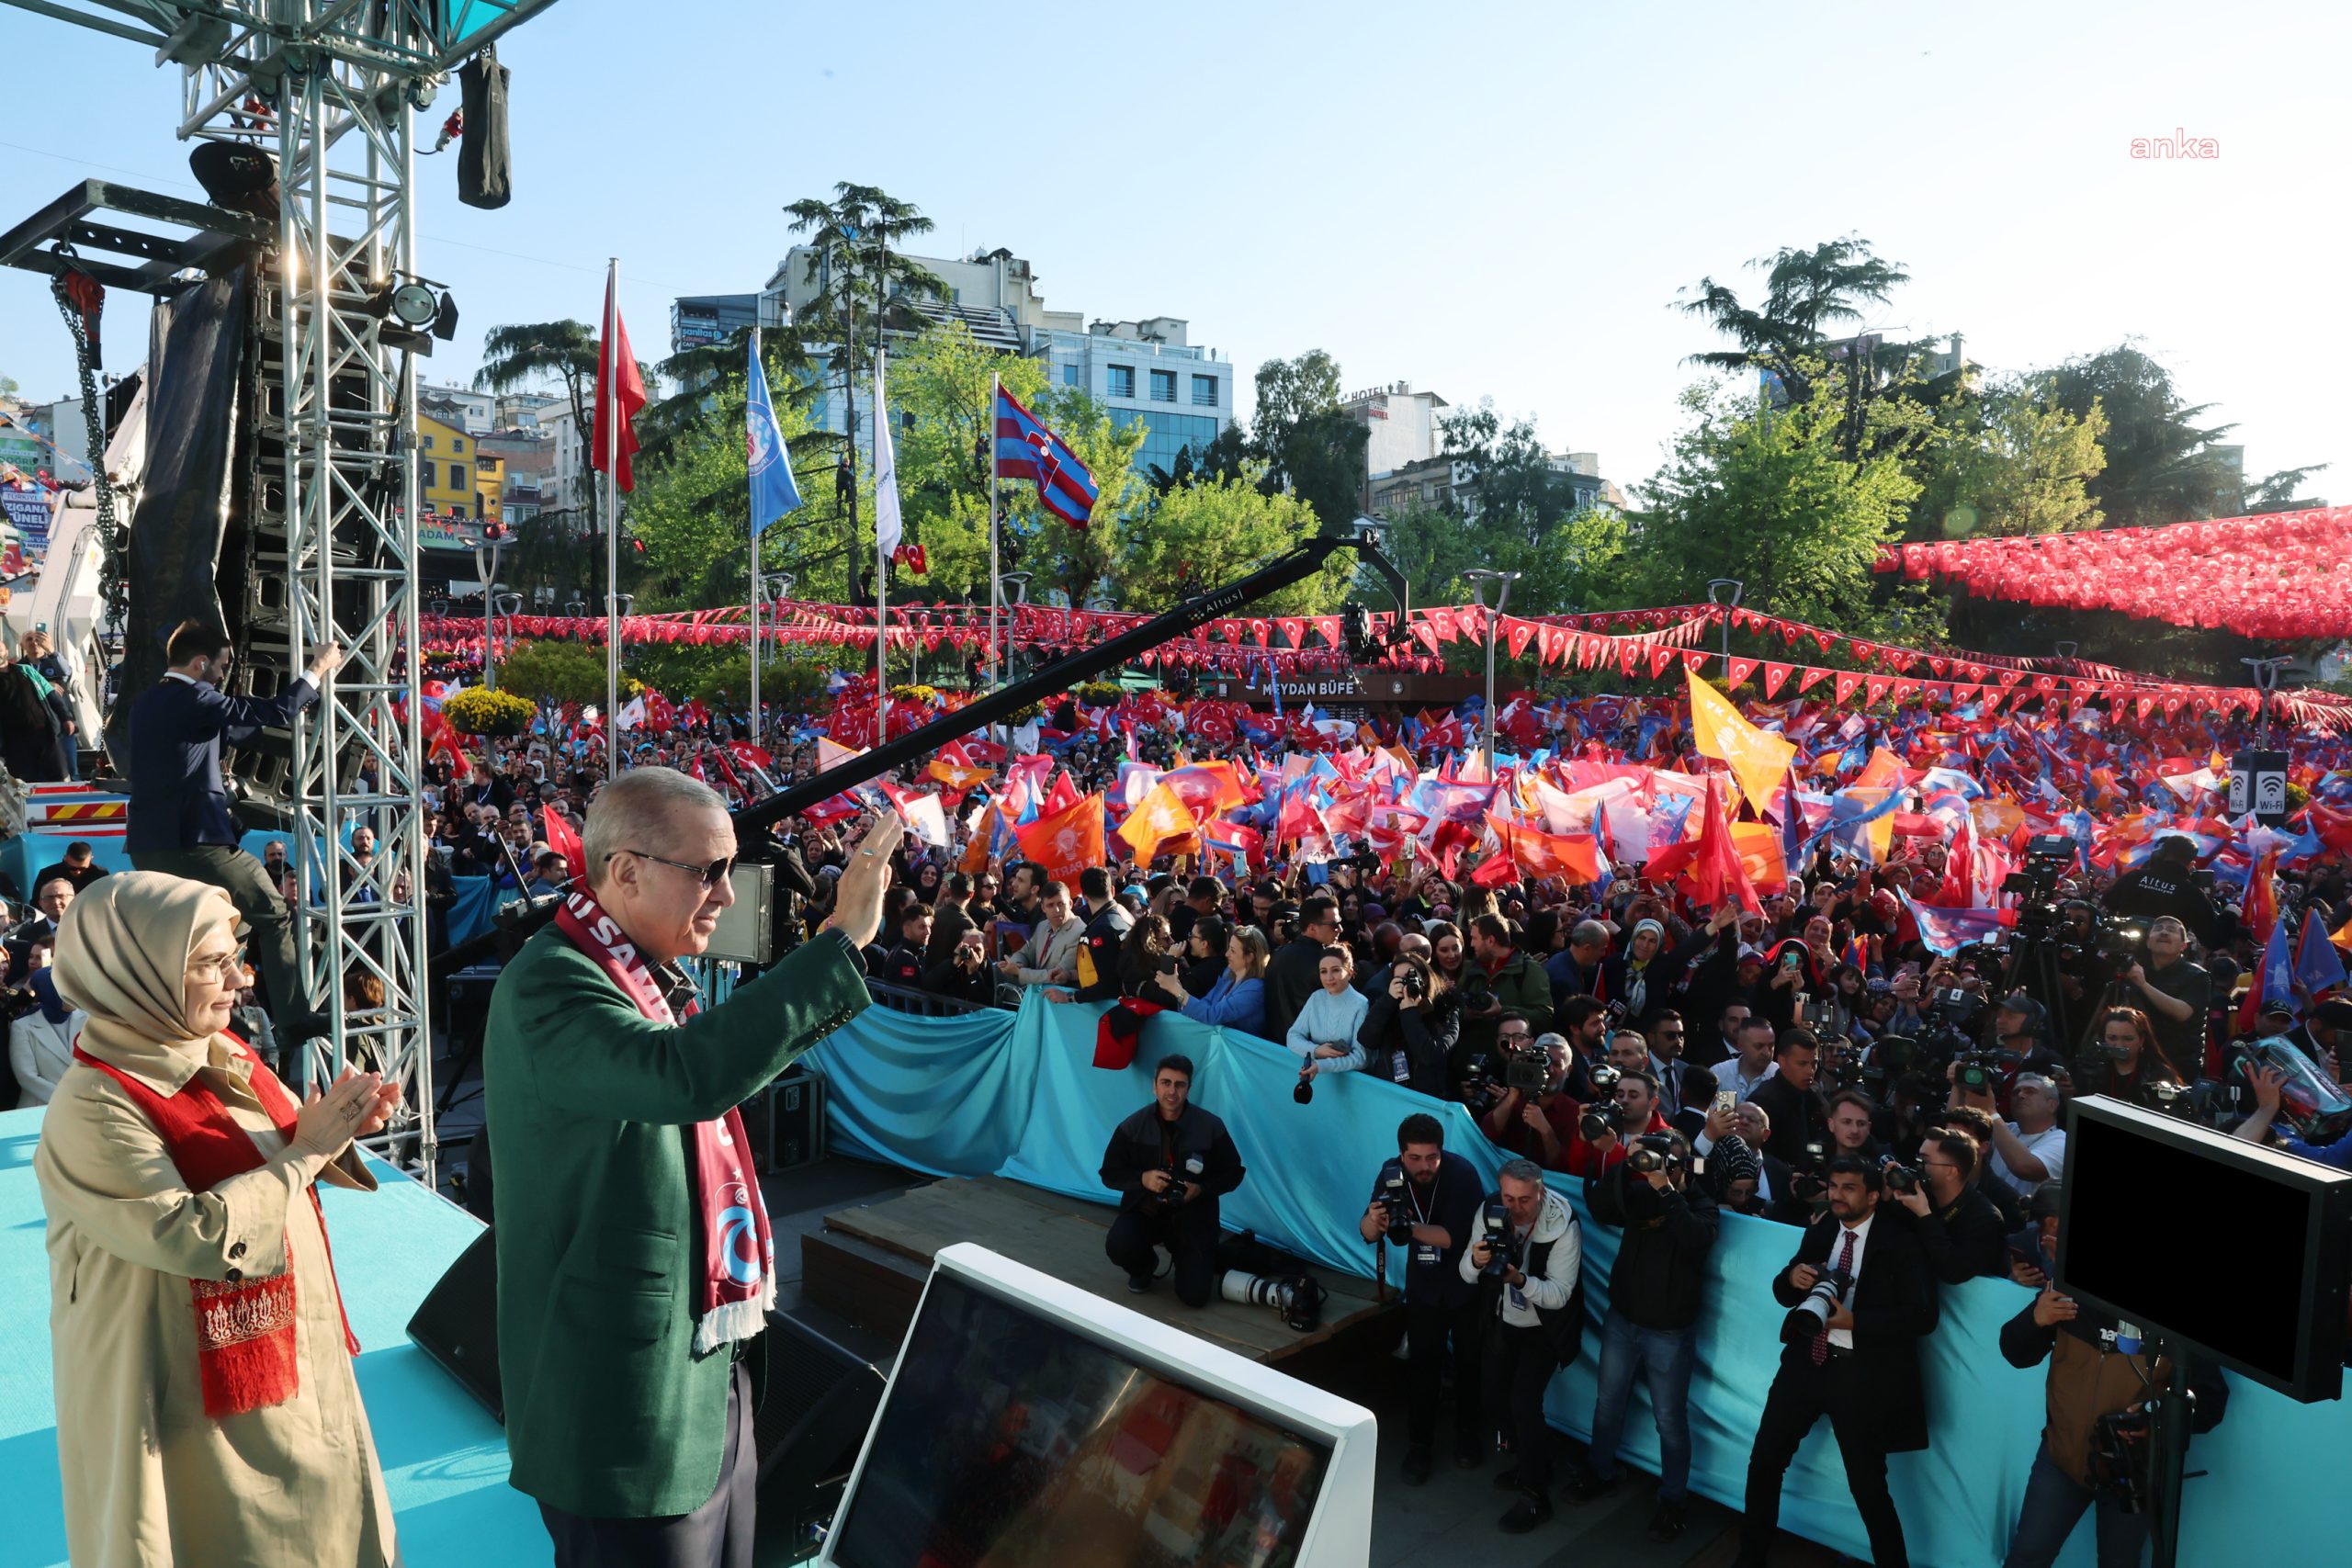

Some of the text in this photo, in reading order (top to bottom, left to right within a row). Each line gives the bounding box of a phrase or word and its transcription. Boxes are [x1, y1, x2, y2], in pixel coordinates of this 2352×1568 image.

[1351, 386, 1383, 401] HOTEL
[419, 529, 455, 541] ADAM
[1320, 680, 1354, 695] BÜFE
[2231, 799, 2244, 809] Wi-Fi
[2260, 800, 2283, 810] Wi-Fi
[2140, 875, 2177, 891] Altus
